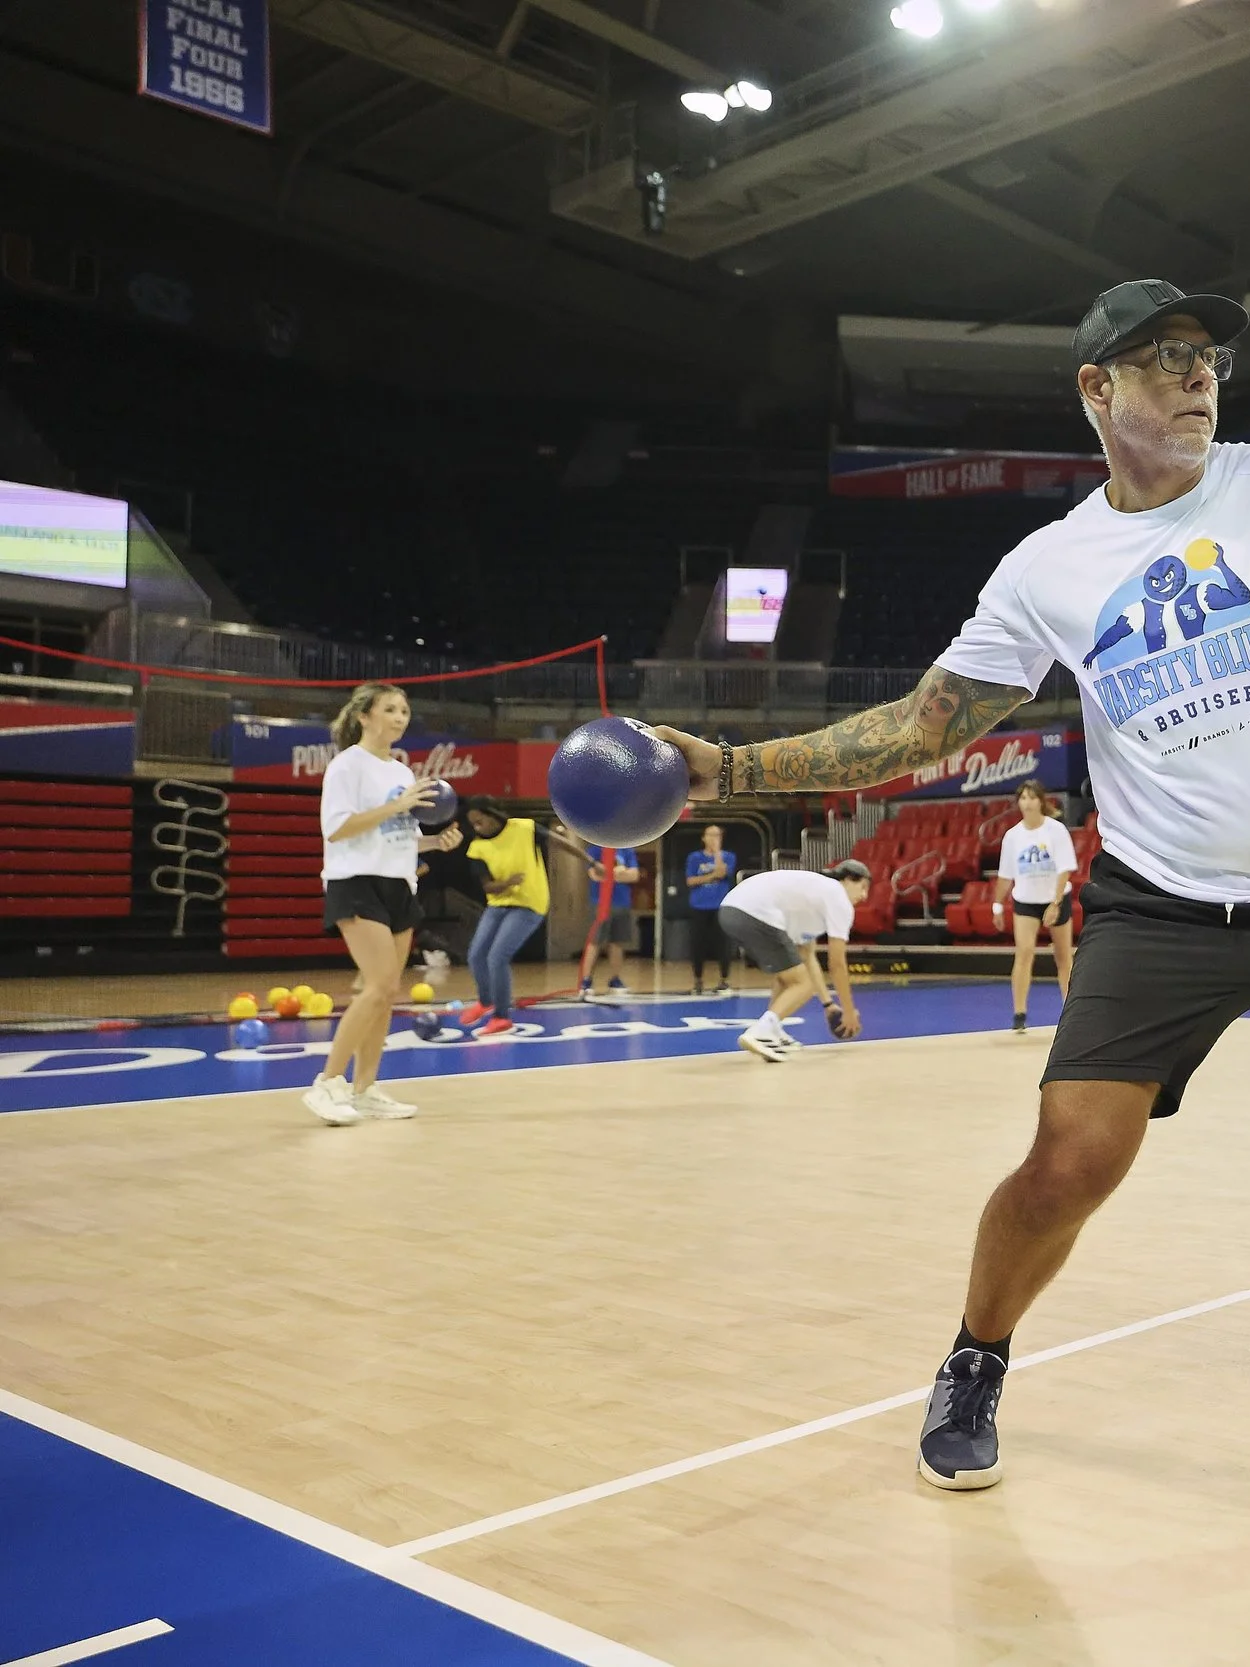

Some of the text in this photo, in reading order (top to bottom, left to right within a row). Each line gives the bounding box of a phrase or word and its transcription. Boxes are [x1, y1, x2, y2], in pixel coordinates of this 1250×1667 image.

[167, 6, 248, 56] FINAL
[172, 0, 244, 28] CAA
[171, 34, 244, 81] FOUR
[906, 467, 947, 498] HALL
[960, 459, 1006, 491] FAME
[1179, 603, 1198, 621] VB
[1093, 645, 1204, 728] VARSITY
[1138, 729, 1150, 742] &
[1203, 729, 1230, 743] BRANDS
[961, 739, 1040, 793] Dallas
